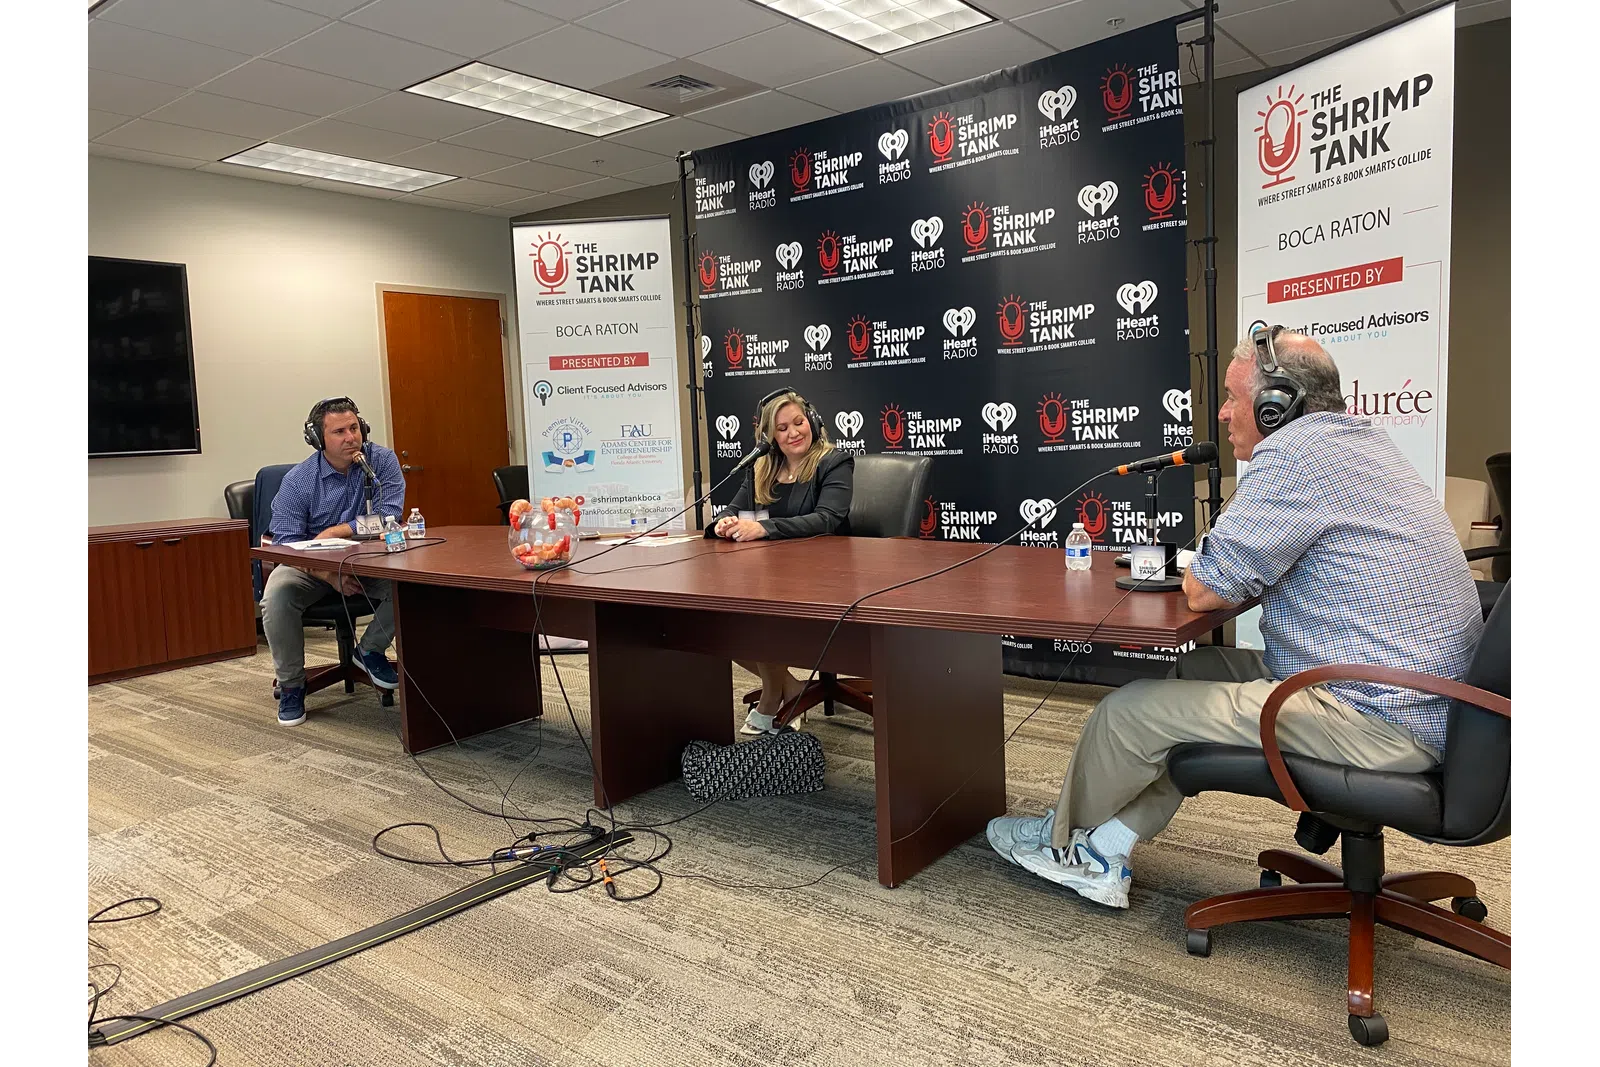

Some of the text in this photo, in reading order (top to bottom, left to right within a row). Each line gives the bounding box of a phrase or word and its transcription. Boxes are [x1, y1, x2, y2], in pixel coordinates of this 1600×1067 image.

[1137, 64, 1158, 77] THE
[1138, 69, 1181, 95] SHRI
[1310, 84, 1342, 110] THE
[1311, 73, 1434, 142] SHRIMP
[957, 114, 973, 126] THE
[1102, 124, 1118, 133] WHERE
[1119, 119, 1136, 129] STREET
[1136, 114, 1156, 124] SMARTS
[1161, 109, 1174, 118] BOOK
[958, 114, 1017, 142] SHRIMP
[1040, 118, 1079, 138] iHeart
[959, 136, 1000, 158] TANK
[1040, 130, 1080, 149] RADIO
[814, 151, 827, 160] THE
[1310, 122, 1391, 174] TANK
[815, 152, 863, 175] SHRIMP
[879, 159, 910, 173] iHeart
[815, 171, 848, 189] TANK
[879, 169, 911, 184] RADIO
[1258, 148, 1432, 207] WHERE STREET SMARTS & BOOK SMARTS COLLIDE
[696, 180, 736, 199] SHRIMP
[749, 188, 775, 202] iHeart
[696, 197, 724, 212] TANK
[749, 198, 776, 210] RADIO
[992, 205, 1010, 216] THE
[993, 208, 1055, 232] SHRIMP
[1078, 215, 1120, 233] iHeart
[1078, 227, 1120, 245] RADIO
[1278, 207, 1391, 251] BOCA RATON
[842, 235, 856, 244] THE
[993, 228, 1036, 248] TANK
[574, 243, 598, 254] THE
[843, 238, 893, 259] SHRIMP
[911, 247, 944, 262] iHeart
[576, 252, 659, 273] SHRIMP
[720, 259, 761, 276] SHRIMP
[843, 255, 879, 274] TANK
[911, 258, 945, 272] RADIO
[720, 275, 750, 290] TANK
[776, 269, 804, 281] iHeart
[1283, 266, 1384, 299] PRESENTED BY
[576, 274, 636, 294] TANK
[776, 279, 804, 291] RADIO
[1030, 300, 1047, 310] THE
[1030, 303, 1095, 328] SHRIMP
[1116, 314, 1159, 330] iHeart
[1311, 316, 1364, 336] Focused
[1367, 310, 1429, 329] Advisors
[556, 323, 638, 337] BOCA RATON
[873, 321, 887, 330] THE
[1030, 323, 1075, 343] TANK
[746, 334, 758, 342] THE
[873, 326, 925, 344] SHRIMP
[1117, 326, 1160, 341] RADIO
[1331, 334, 1362, 344] ABOUT
[1368, 330, 1387, 339] YOU
[746, 340, 790, 355] SHRIMP
[874, 343, 910, 359] TANK
[943, 337, 977, 350] iHeart
[804, 352, 832, 363] iHeart
[943, 347, 978, 360] RADIO
[562, 356, 637, 368] PRESENTED BY
[747, 354, 777, 369] TANK
[805, 361, 833, 372] RADIO
[557, 382, 667, 395] Client Focused Advisors
[1071, 399, 1090, 409] THE
[1344, 378, 1432, 416] durée
[907, 411, 922, 420] THE
[1072, 406, 1140, 426] SHRIMP
[542, 416, 592, 438] Premier Virtual
[908, 417, 962, 434] SHRIMP
[1072, 424, 1120, 442] TANK
[1164, 424, 1193, 436] iHea
[563, 433, 572, 448] P
[717, 440, 741, 450] iHeart
[836, 438, 865, 449] iHeart
[908, 434, 946, 448] TANK
[983, 433, 1018, 445] iHeart
[1164, 436, 1193, 447] RAD
[601, 446, 672, 455] ENTREPRENEURSHIP
[717, 450, 742, 458] RADIO
[983, 444, 1019, 455] RADIO
[591, 494, 661, 504] @shrimptankboca
[940, 502, 956, 510] THE
[1112, 502, 1131, 510] THE
[941, 510, 997, 526] SHRIMP
[1112, 511, 1183, 527] SHRMP
[941, 526, 981, 540] TANK
[1021, 531, 1058, 541] iHeart
[1054, 642, 1092, 654] RADIO
